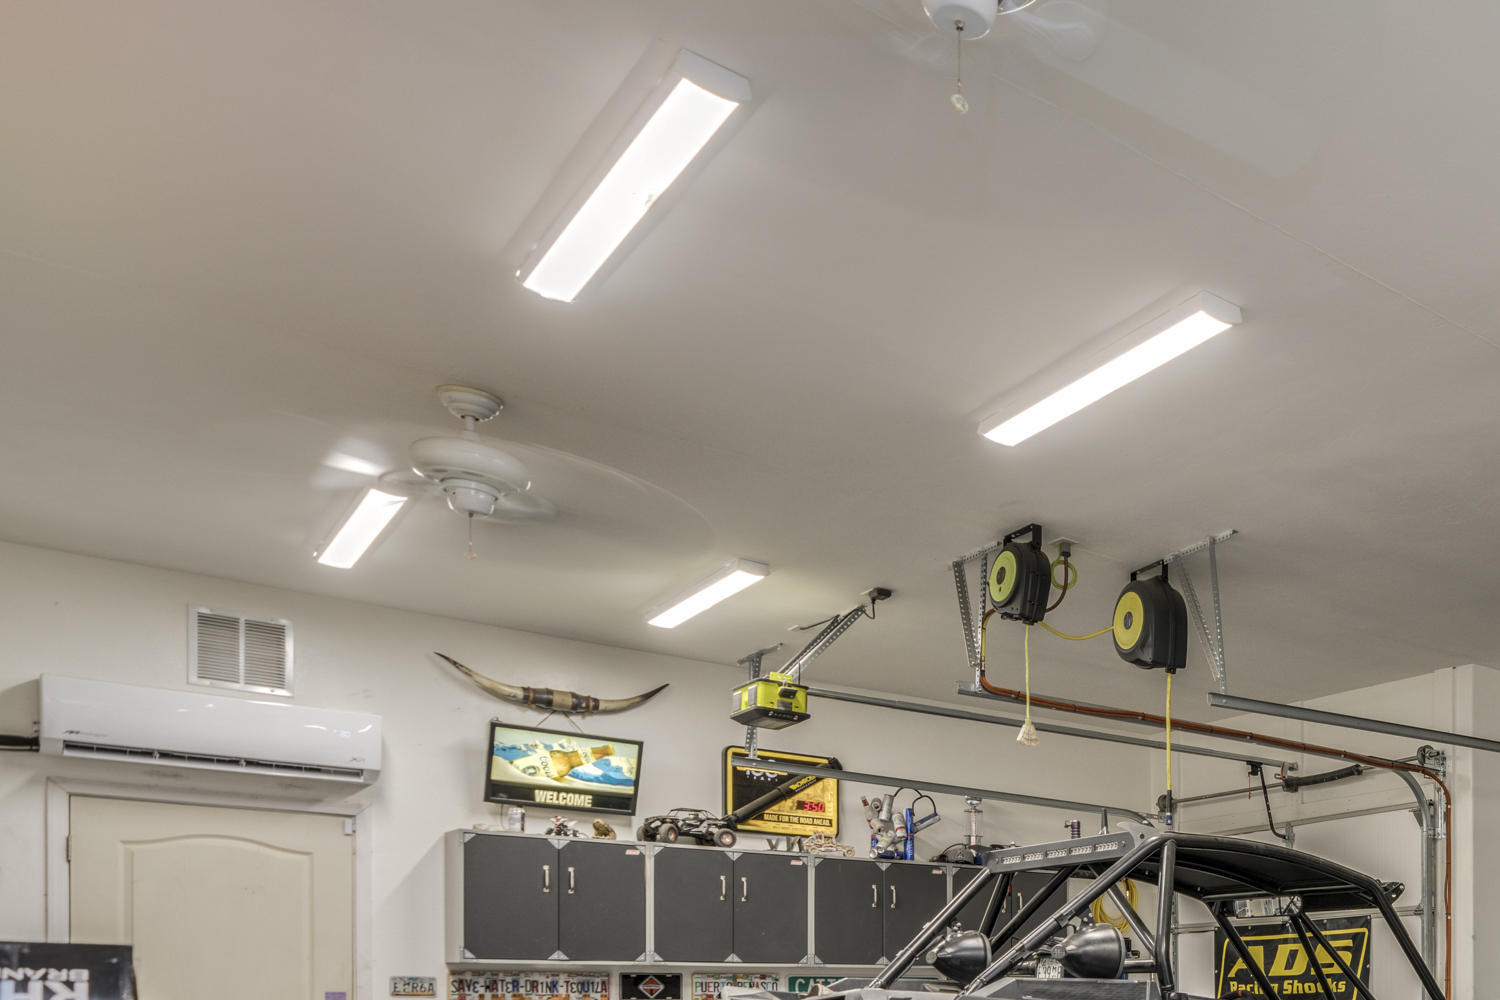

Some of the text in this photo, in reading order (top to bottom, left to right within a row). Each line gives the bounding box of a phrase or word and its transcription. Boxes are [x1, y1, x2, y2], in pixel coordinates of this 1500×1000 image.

[534, 789, 593, 808] WELCOME
[763, 813, 778, 822] MADE
[779, 815, 789, 823] FOR
[789, 815, 800, 824] THE
[799, 816, 813, 825] ROAD
[1227, 939, 1354, 978] ADS
[1229, 979, 1279, 996] Racig
